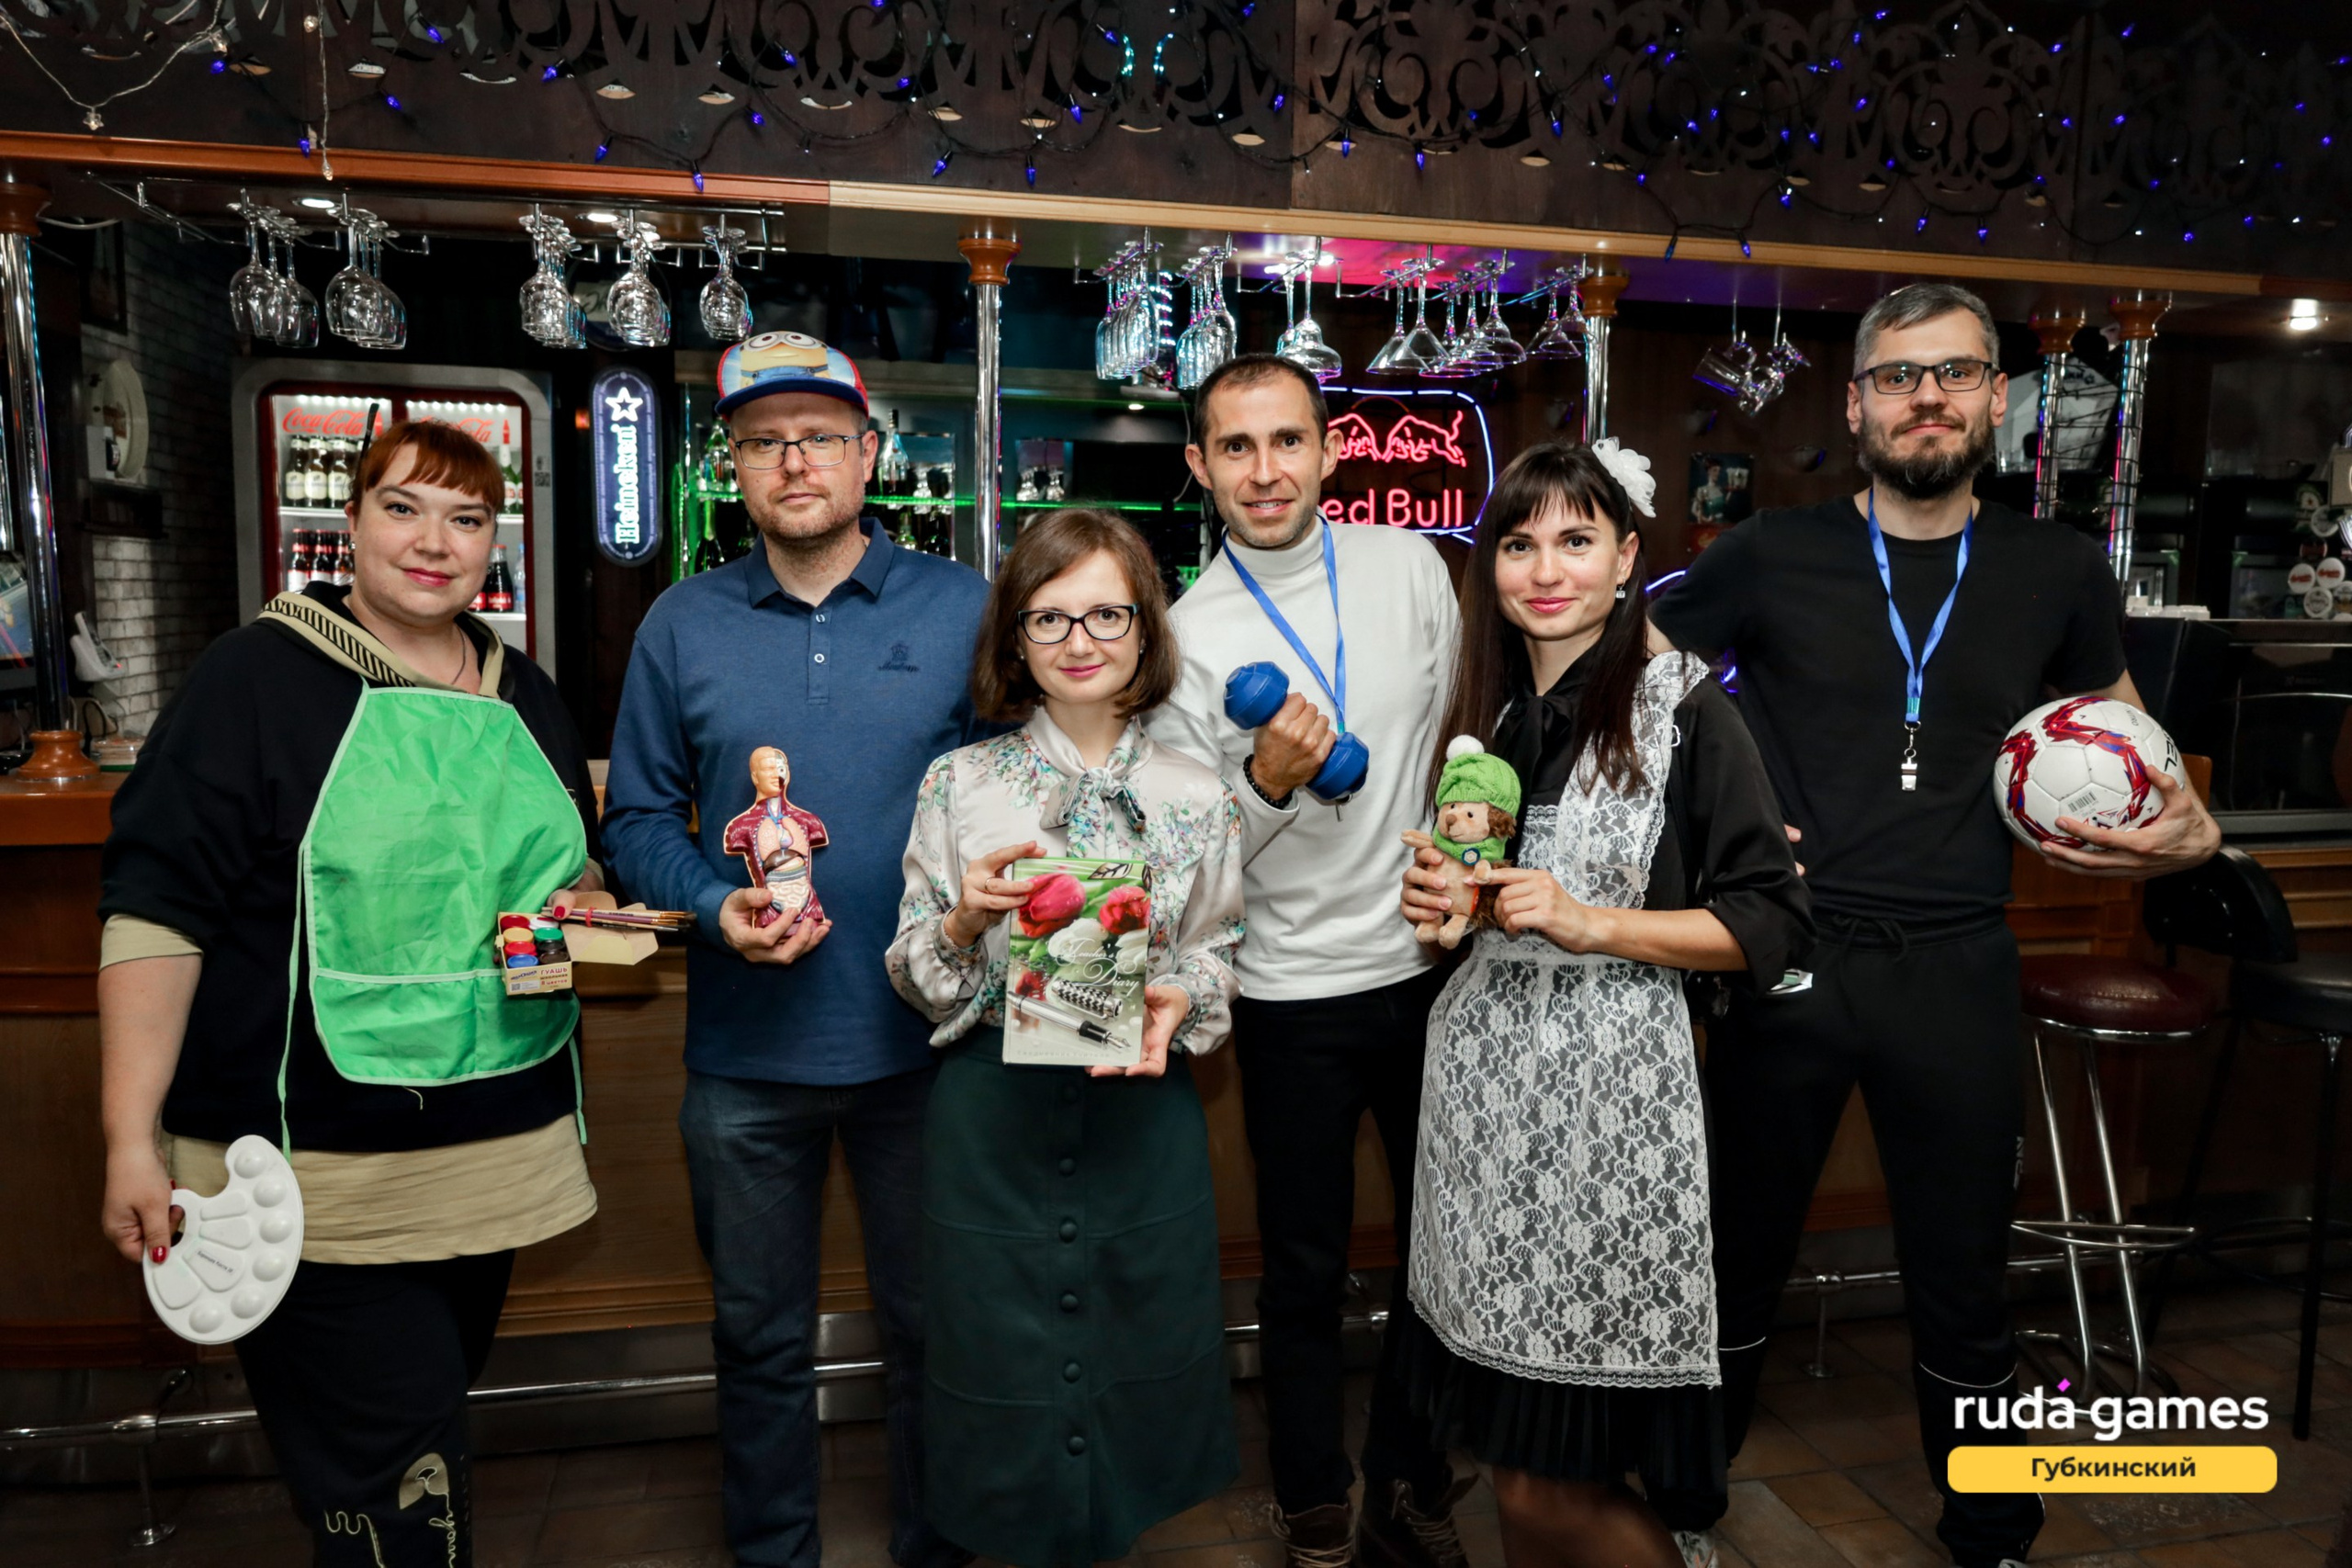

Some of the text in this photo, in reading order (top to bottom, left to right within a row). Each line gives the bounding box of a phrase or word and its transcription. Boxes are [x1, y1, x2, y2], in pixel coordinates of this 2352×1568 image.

[610, 423, 640, 544] Heineken
[1321, 488, 1463, 527] ed Bull
[1072, 957, 1140, 997] Diary
